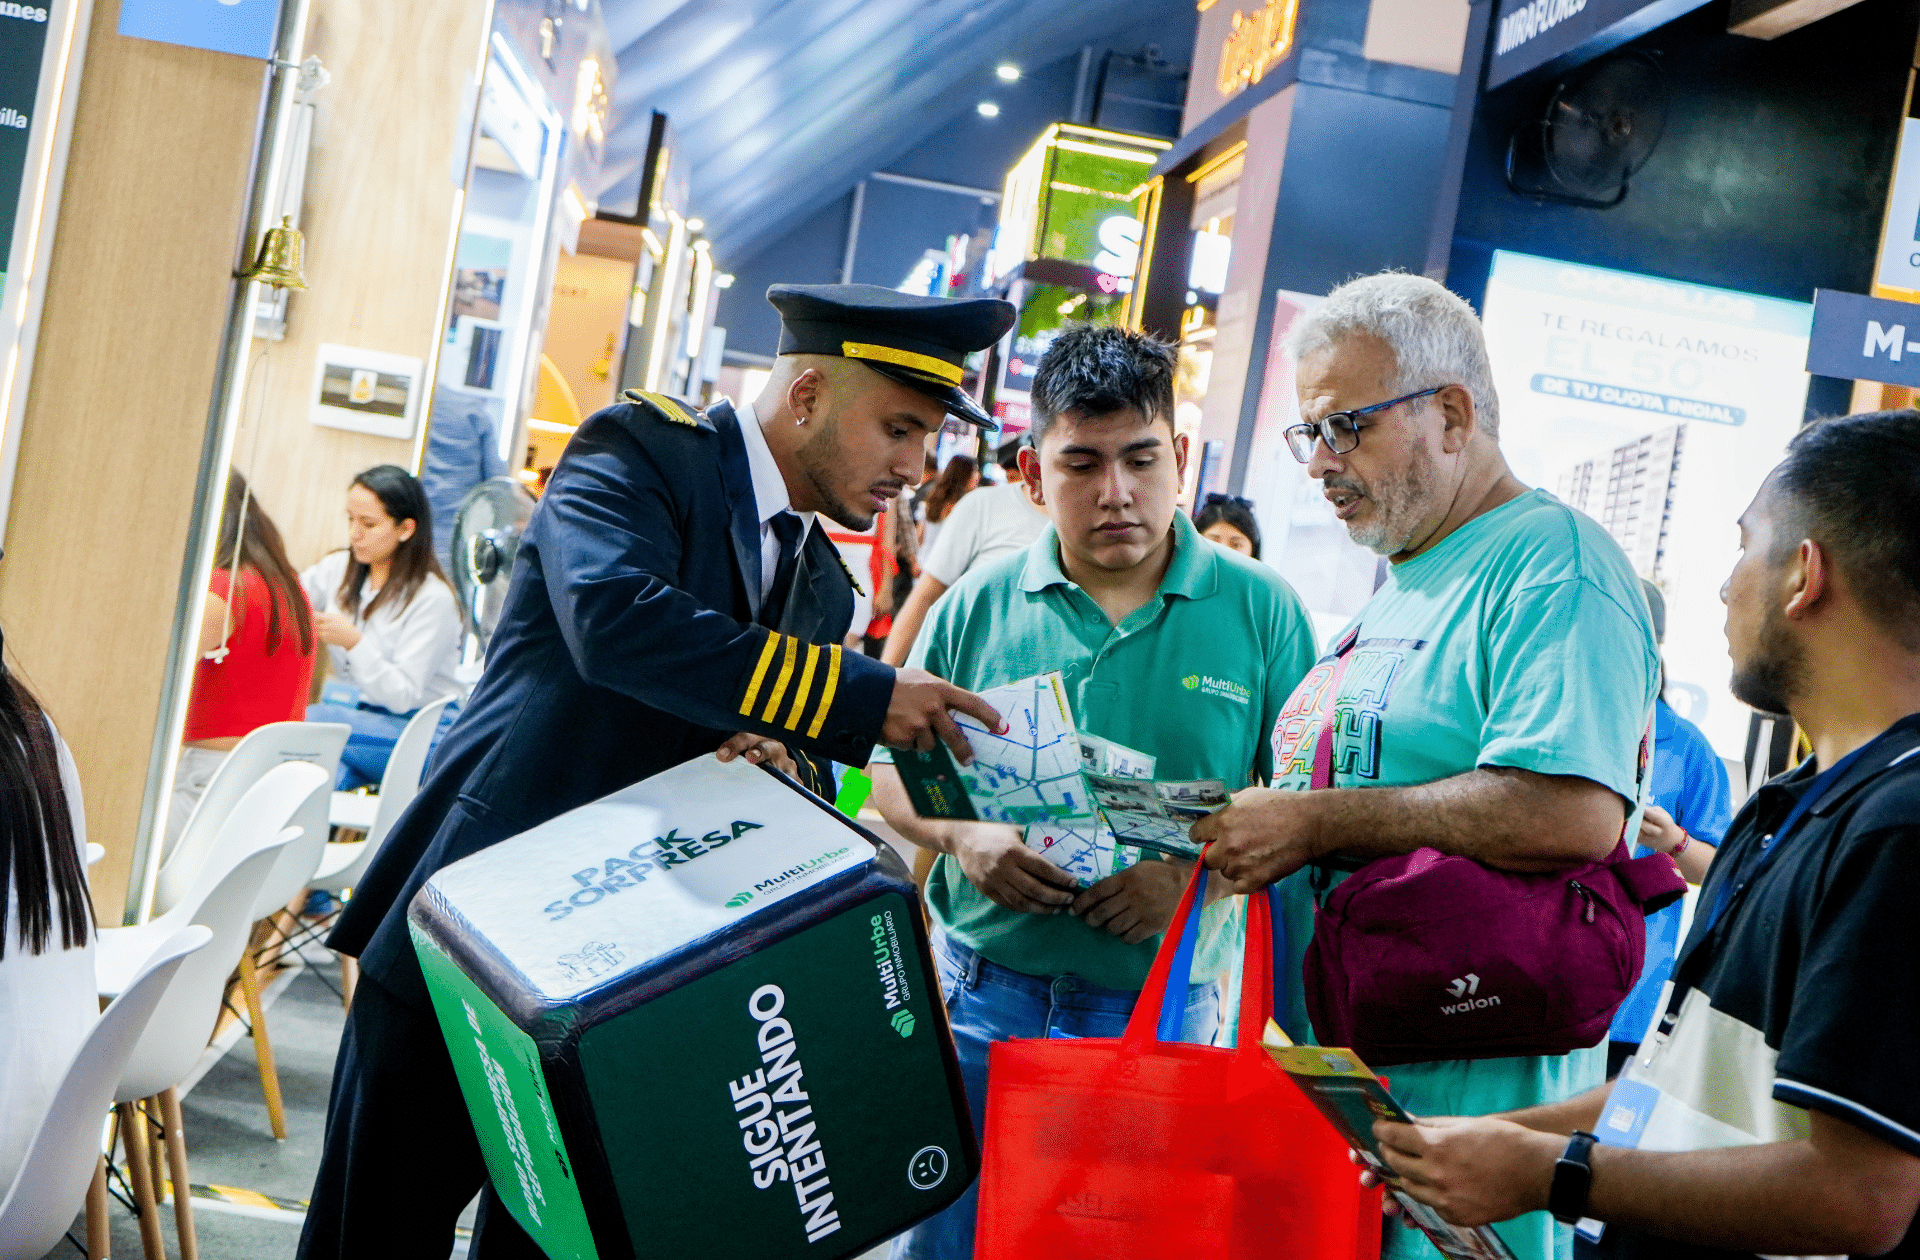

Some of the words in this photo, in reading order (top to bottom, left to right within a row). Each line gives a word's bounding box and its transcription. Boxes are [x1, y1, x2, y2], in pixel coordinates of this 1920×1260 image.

[0, 107, 27, 128] illa
[1541, 312, 1570, 331] TE
[1580, 318, 1759, 363] REGALAMOS
[1544, 334, 1608, 377] EL
[1541, 376, 1569, 395] DE
[1571, 382, 1599, 400] TU
[1600, 388, 1666, 412] CUOTA
[1202, 675, 1251, 698] MultiUrbe
[543, 820, 764, 921] SORPRESA
[571, 828, 694, 889] PACK
[754, 847, 850, 891] MultiUrbe
[763, 879, 796, 896] GRUPO
[795, 851, 855, 881] INMOBILIARIO
[870, 914, 902, 1010] MultiUrbe
[884, 910, 904, 970] INMOBILIARIO
[897, 969, 911, 1001] GRUPO
[1440, 995, 1501, 1016] walon
[462, 998, 482, 1036] DE
[474, 1036, 521, 1160] SORPRESA
[748, 984, 842, 1244] INTENTANDO
[729, 1067, 790, 1190] SIGUE
[514, 1160, 543, 1228] BONO
